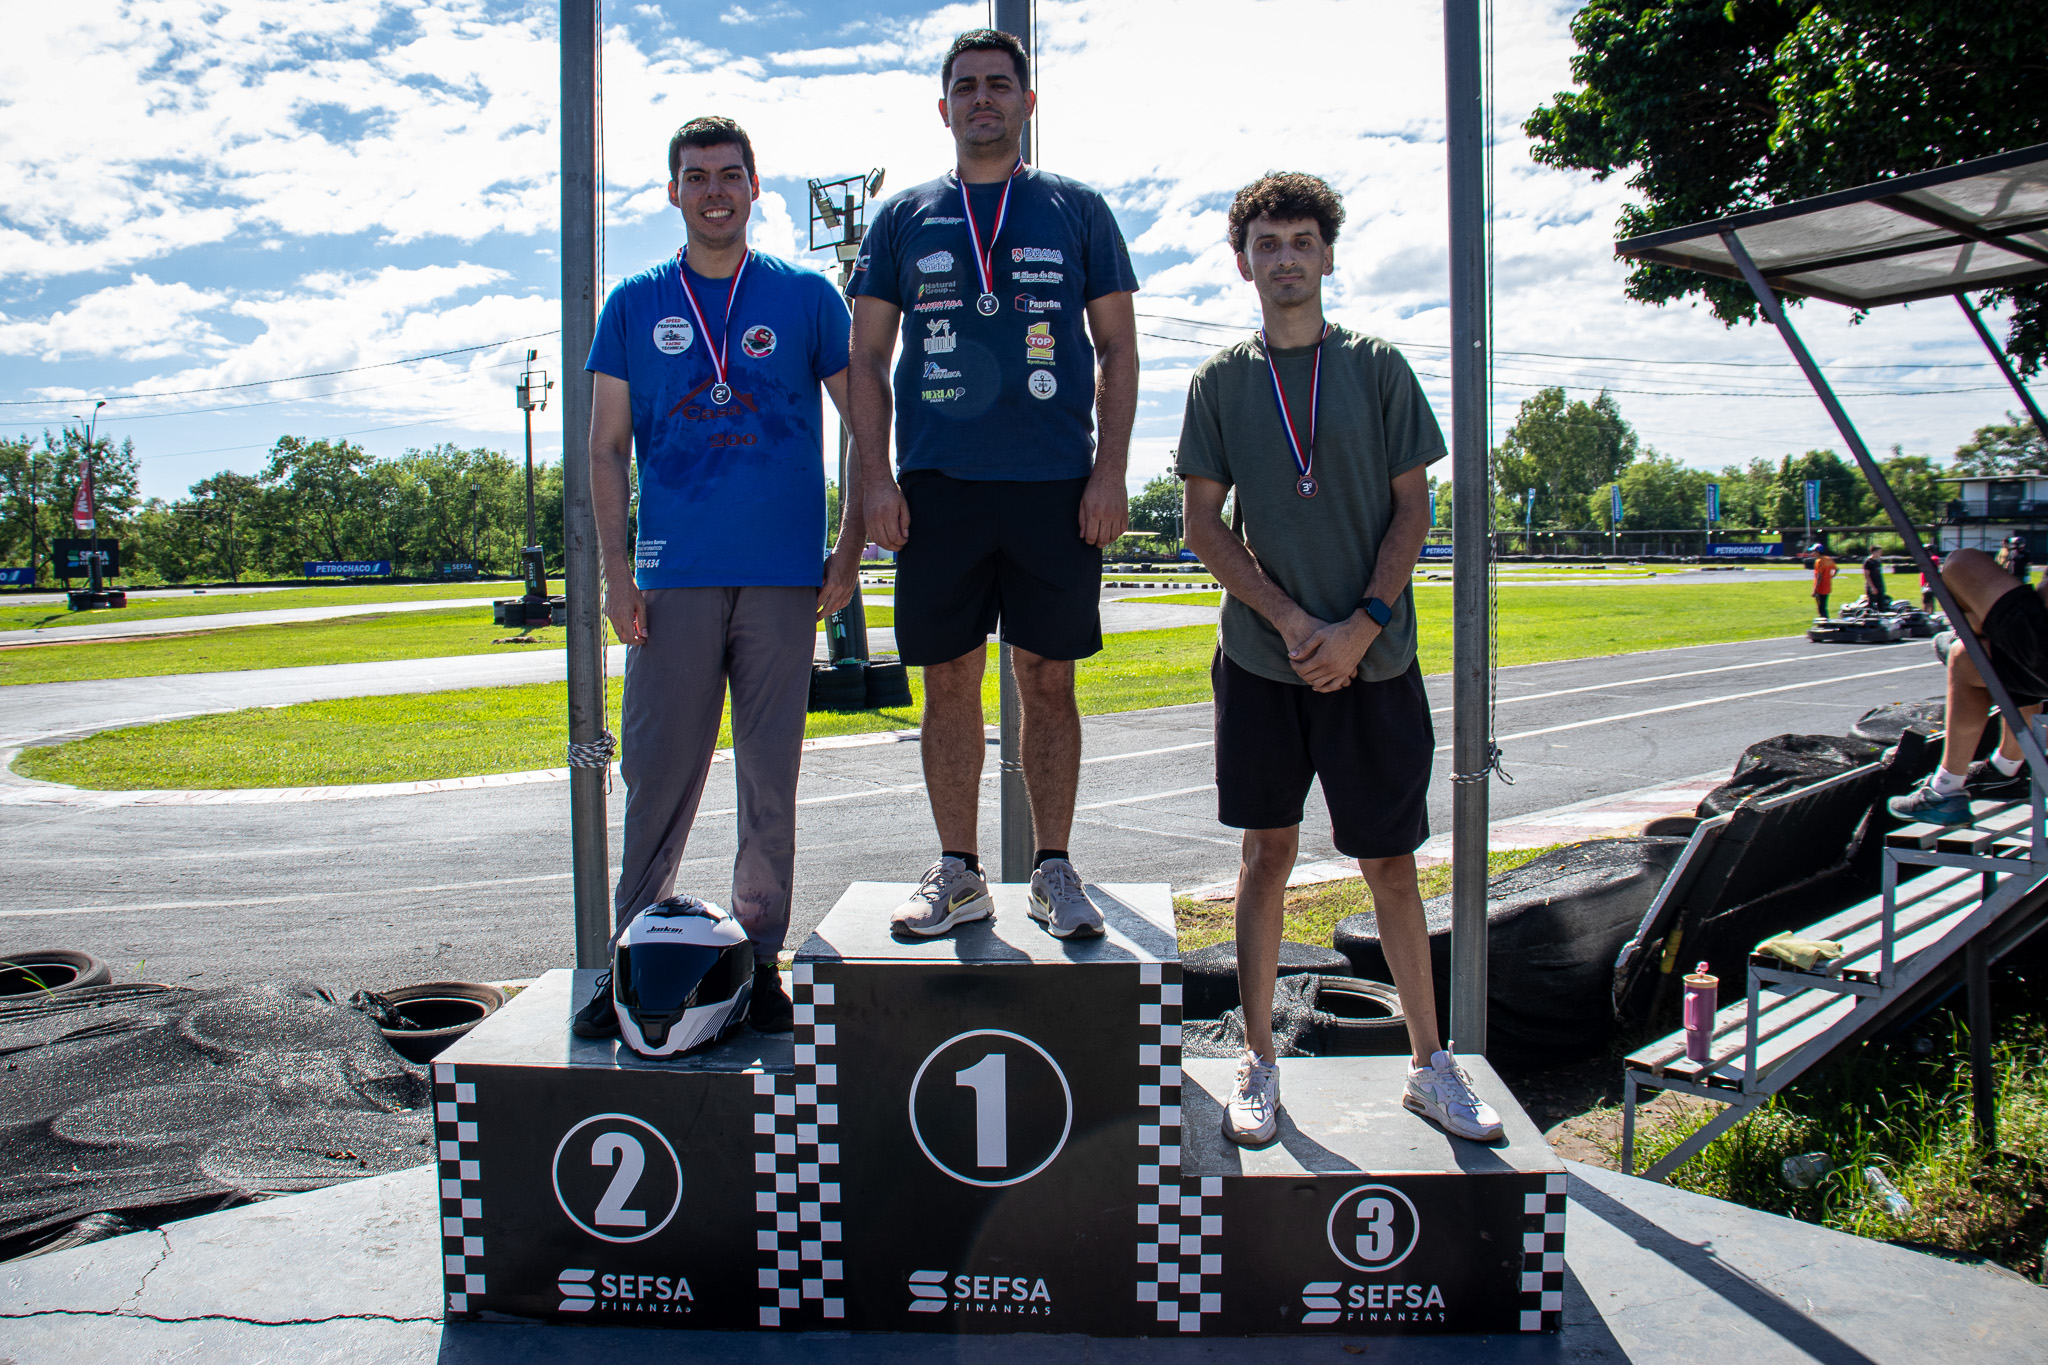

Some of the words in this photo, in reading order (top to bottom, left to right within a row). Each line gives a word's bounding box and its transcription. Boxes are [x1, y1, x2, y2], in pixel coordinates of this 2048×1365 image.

[925, 280, 956, 289] Natural
[925, 287, 949, 295] Group
[1030, 336, 1052, 346] TOP
[921, 388, 955, 400] MERLO
[682, 404, 743, 421] Casa
[709, 433, 758, 449] 200
[1716, 546, 1765, 554] PETROCHACO
[315, 564, 371, 573] PETROCHACO
[956, 1053, 1007, 1167] 1
[591, 1132, 647, 1227] 2
[1356, 1197, 1395, 1261] 3
[601, 1273, 694, 1301] SEFSA
[953, 1274, 1051, 1302] SEFSA
[1348, 1284, 1446, 1309] SEFSA
[953, 1302, 1051, 1315] FINANZAS
[1348, 1312, 1446, 1323] FINANZAS
